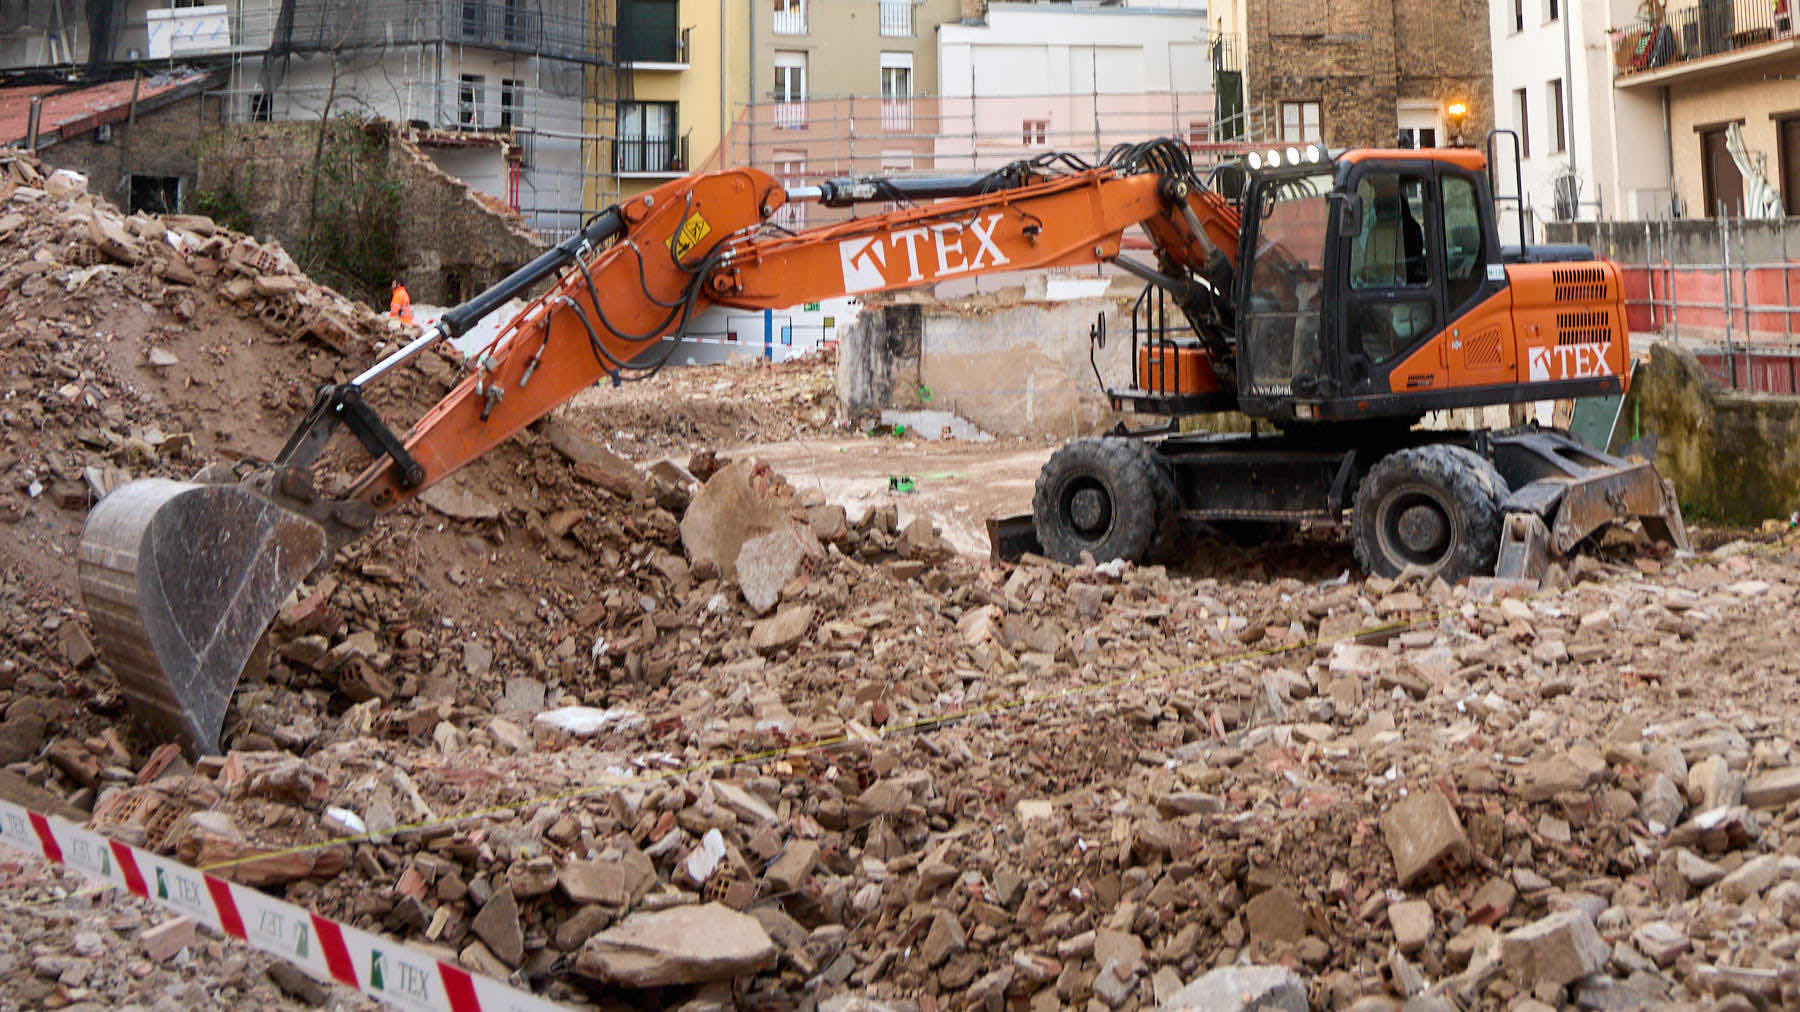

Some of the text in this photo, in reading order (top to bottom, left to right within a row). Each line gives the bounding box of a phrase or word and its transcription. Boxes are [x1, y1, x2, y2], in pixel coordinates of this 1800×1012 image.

[890, 213, 1010, 283] TEX
[1553, 341, 1613, 380] TEX
[176, 875, 201, 905] TEX
[398, 961, 431, 1001] TEX
